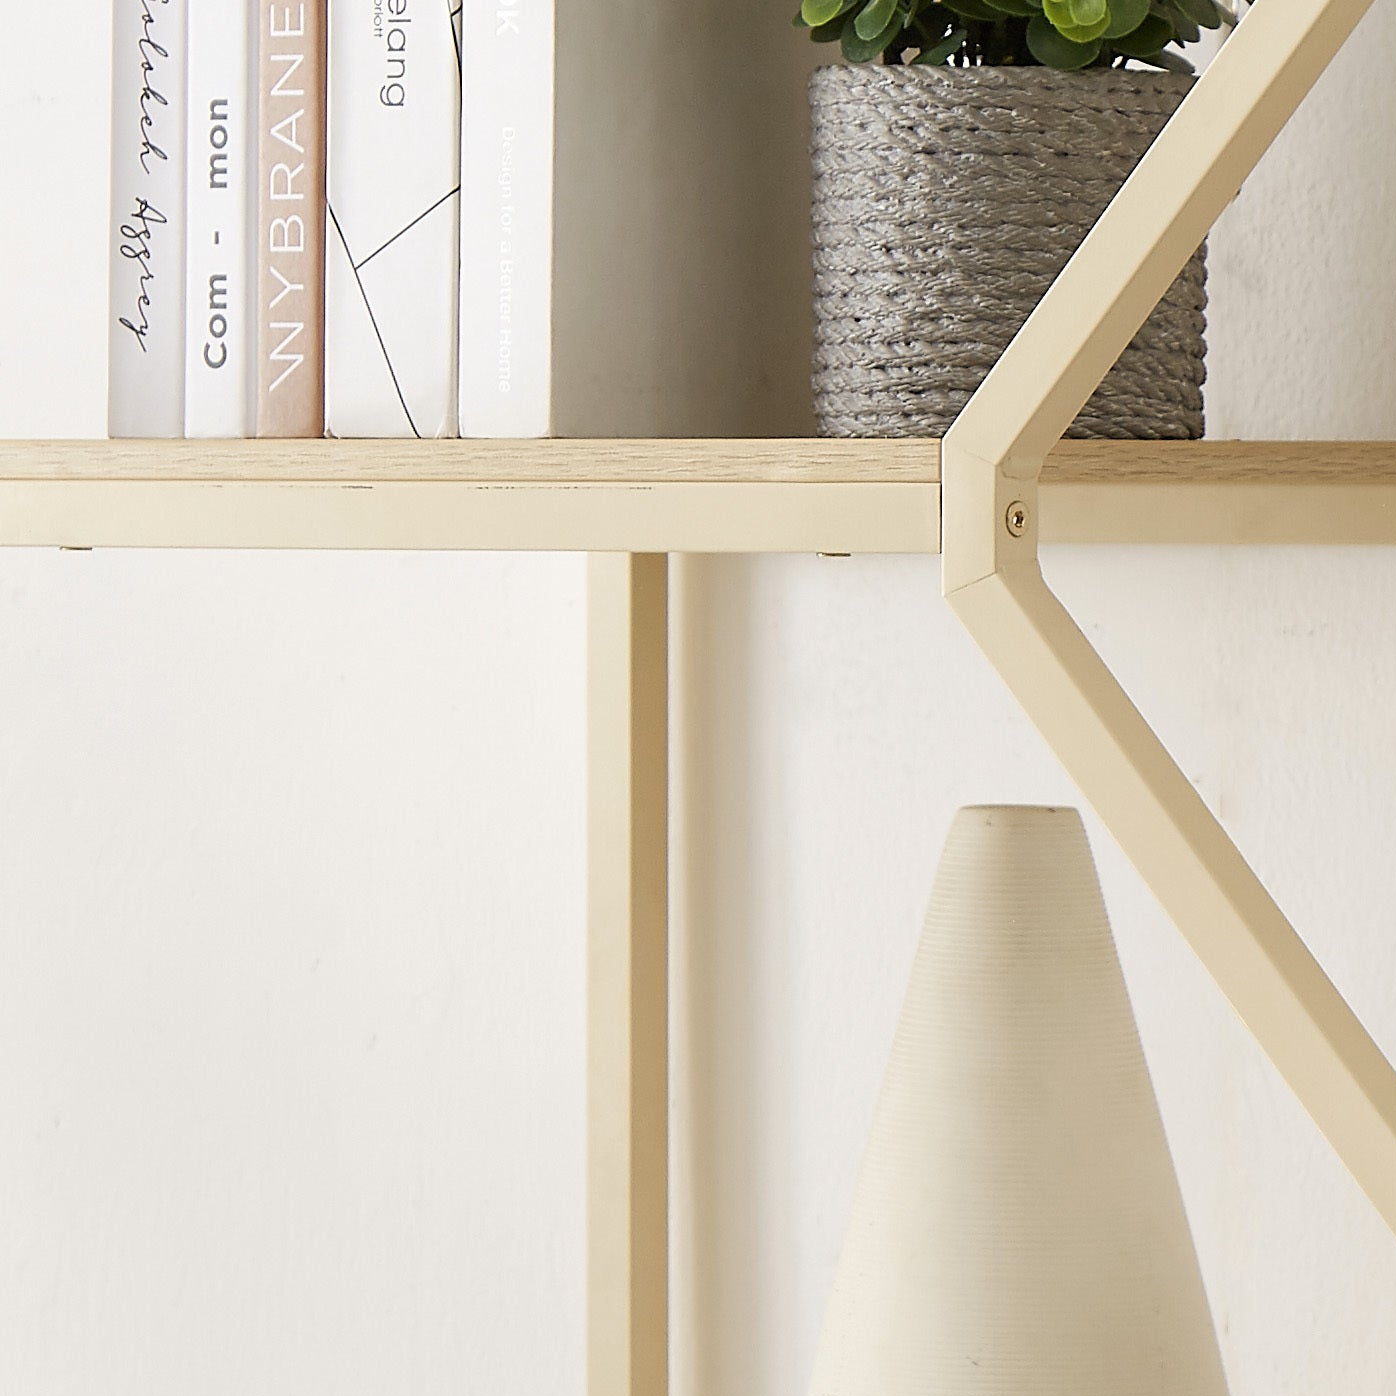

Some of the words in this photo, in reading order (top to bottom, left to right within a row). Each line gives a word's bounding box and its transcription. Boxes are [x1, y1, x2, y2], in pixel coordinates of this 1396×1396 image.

[209, 98, 229, 189] mon
[496, 127, 517, 199] Design
[267, 3, 304, 393] WYBRANE
[499, 205, 516, 236] for
[499, 240, 512, 254] a
[203, 275, 228, 370] Com
[498, 259, 515, 323] Better
[497, 329, 513, 393] Home
